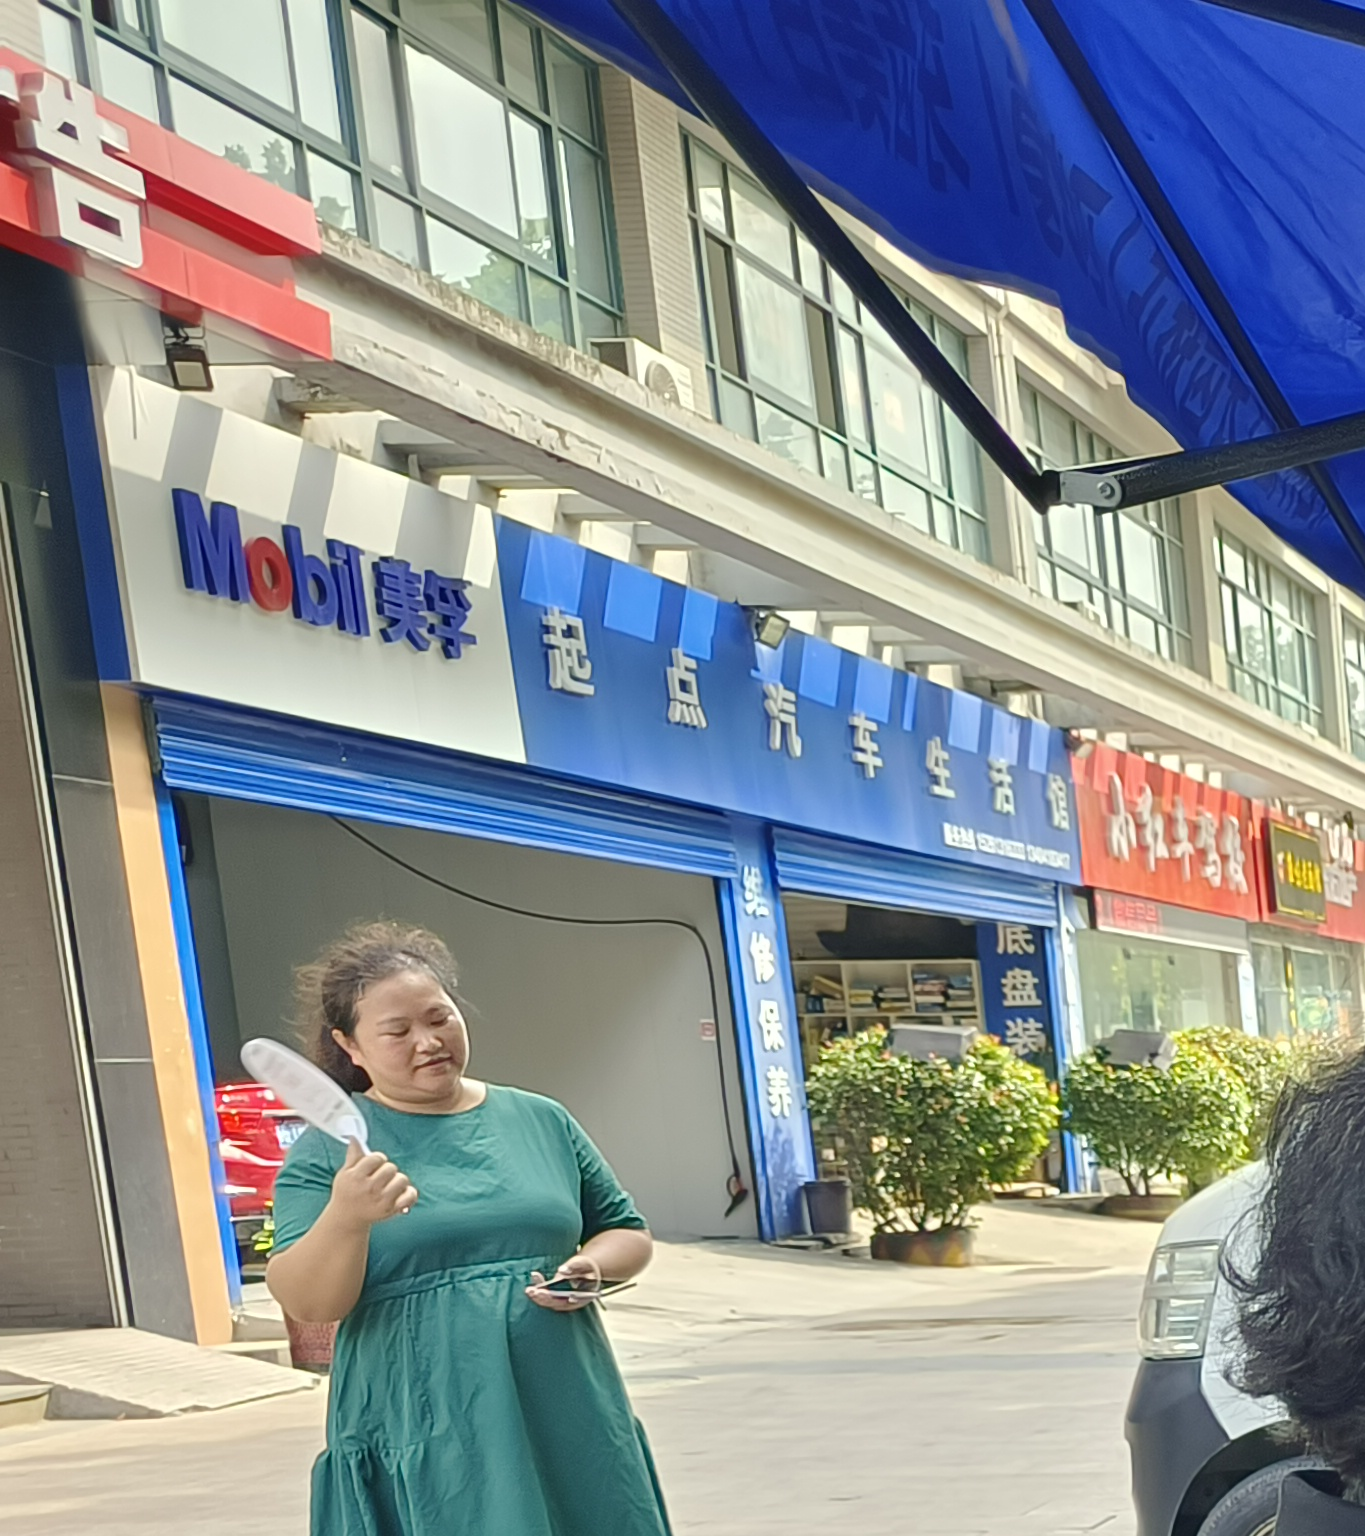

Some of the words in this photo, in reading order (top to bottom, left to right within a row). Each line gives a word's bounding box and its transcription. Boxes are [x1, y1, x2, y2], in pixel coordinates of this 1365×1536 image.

[172, 488, 371, 638] Mobil
[372, 555, 478, 661] 美孚
[541, 605, 1071, 831] 起点汽车生活馆
[742, 866, 792, 1119] 维修保养
